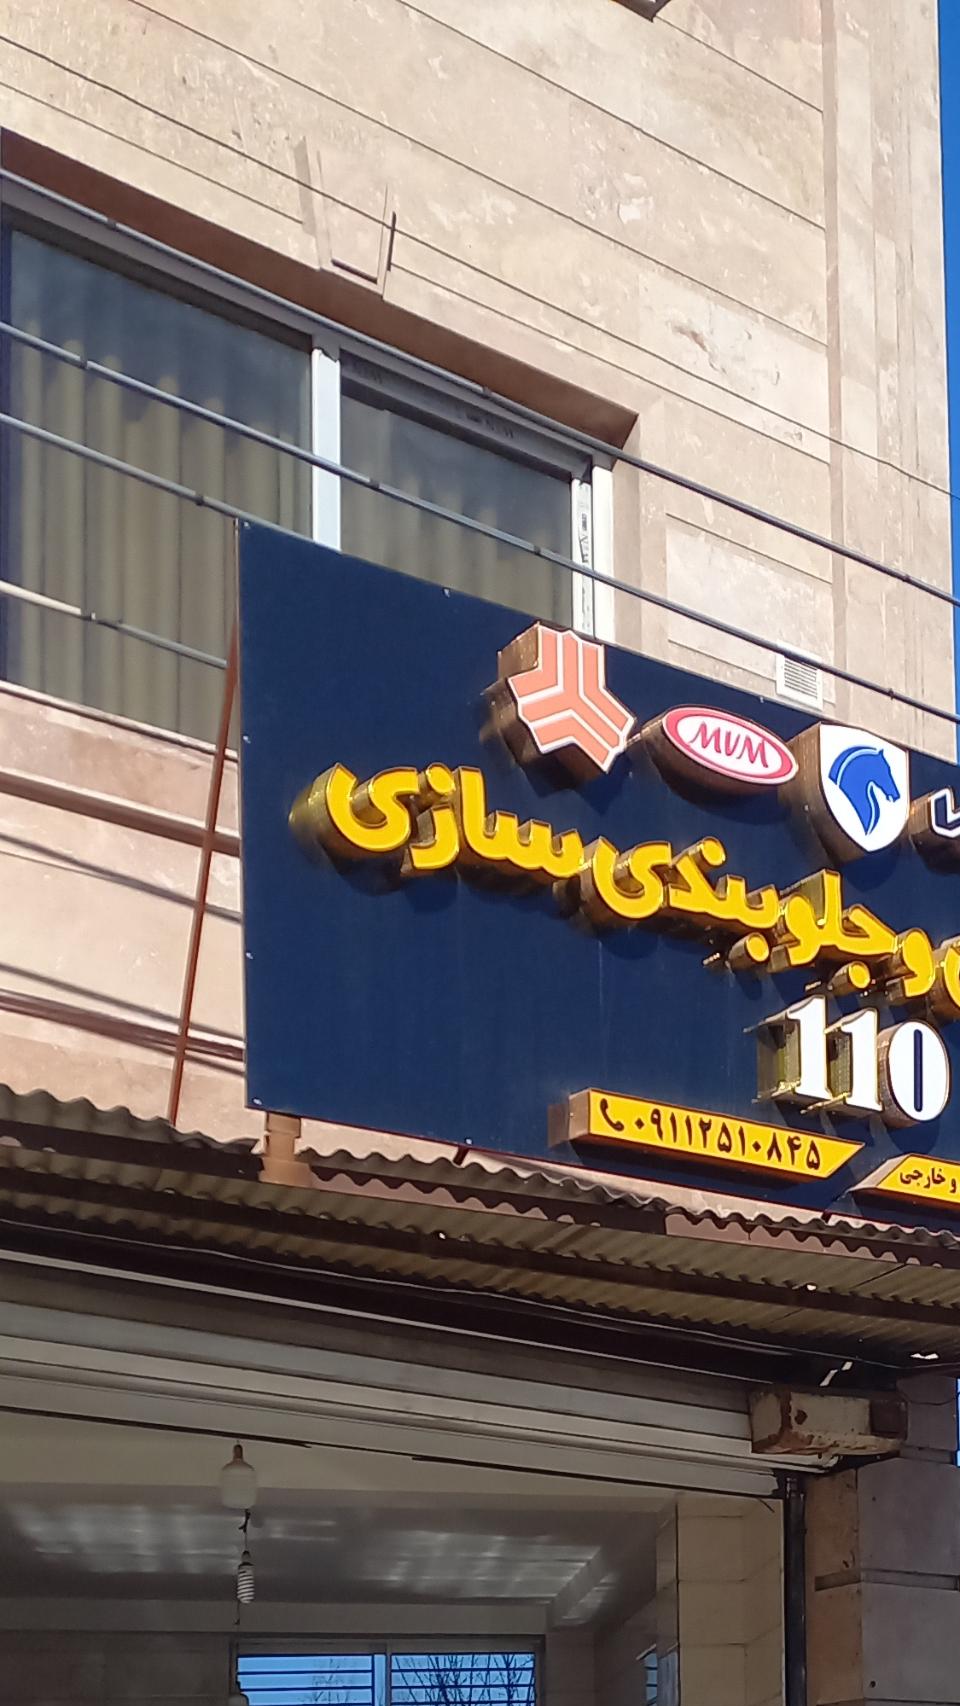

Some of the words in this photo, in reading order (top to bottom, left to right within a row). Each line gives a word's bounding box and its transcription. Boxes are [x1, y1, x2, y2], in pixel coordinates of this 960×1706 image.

[689, 721, 769, 768] MVM
[786, 994, 951, 1122] 110
[634, 1107, 822, 1171] ۰۹۱۱۲۵۱۰۸۴۵
[899, 1167, 946, 1189] خارجی
[950, 1177, 957, 1194] و
